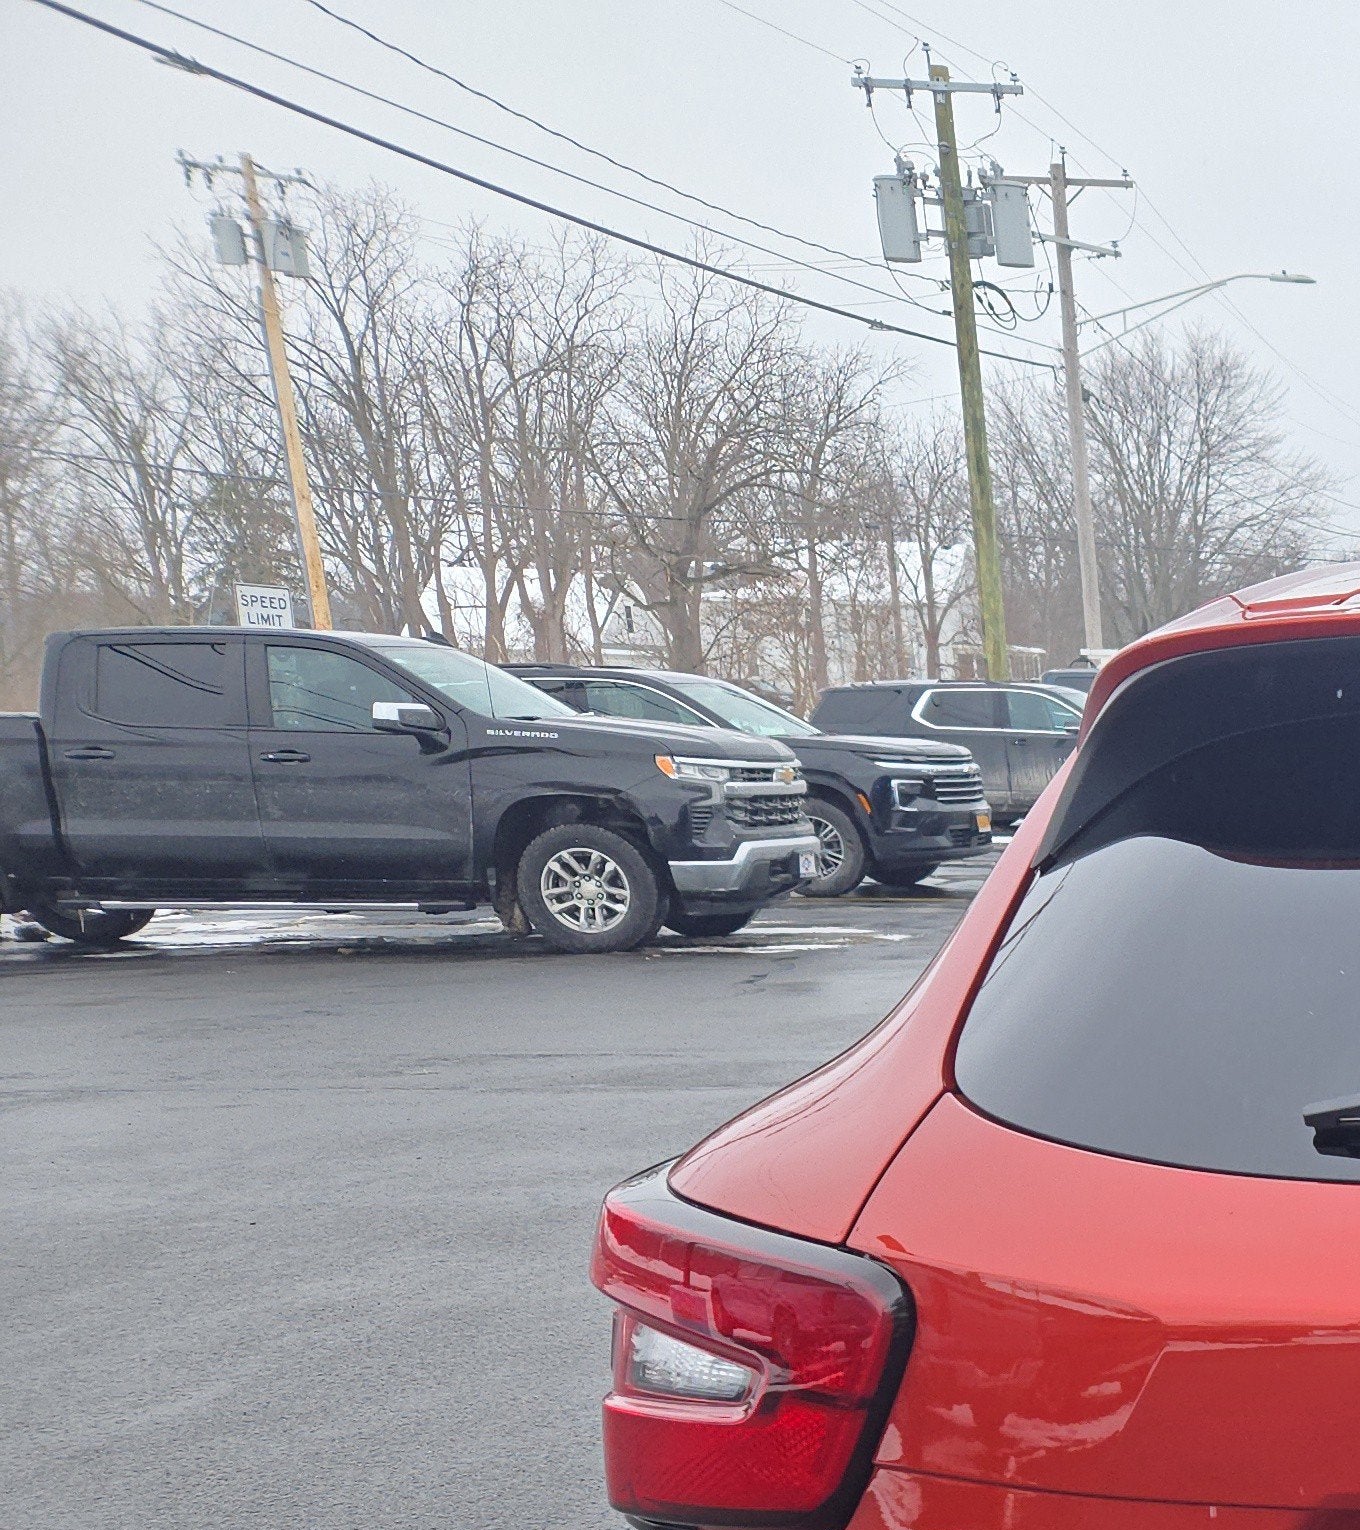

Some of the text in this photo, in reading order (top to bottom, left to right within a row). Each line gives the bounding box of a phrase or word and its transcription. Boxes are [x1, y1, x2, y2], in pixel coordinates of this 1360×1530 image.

[241, 594, 287, 610] SPEED
[247, 611, 283, 627] LIMIT
[486, 729, 559, 739] SILVERADO
